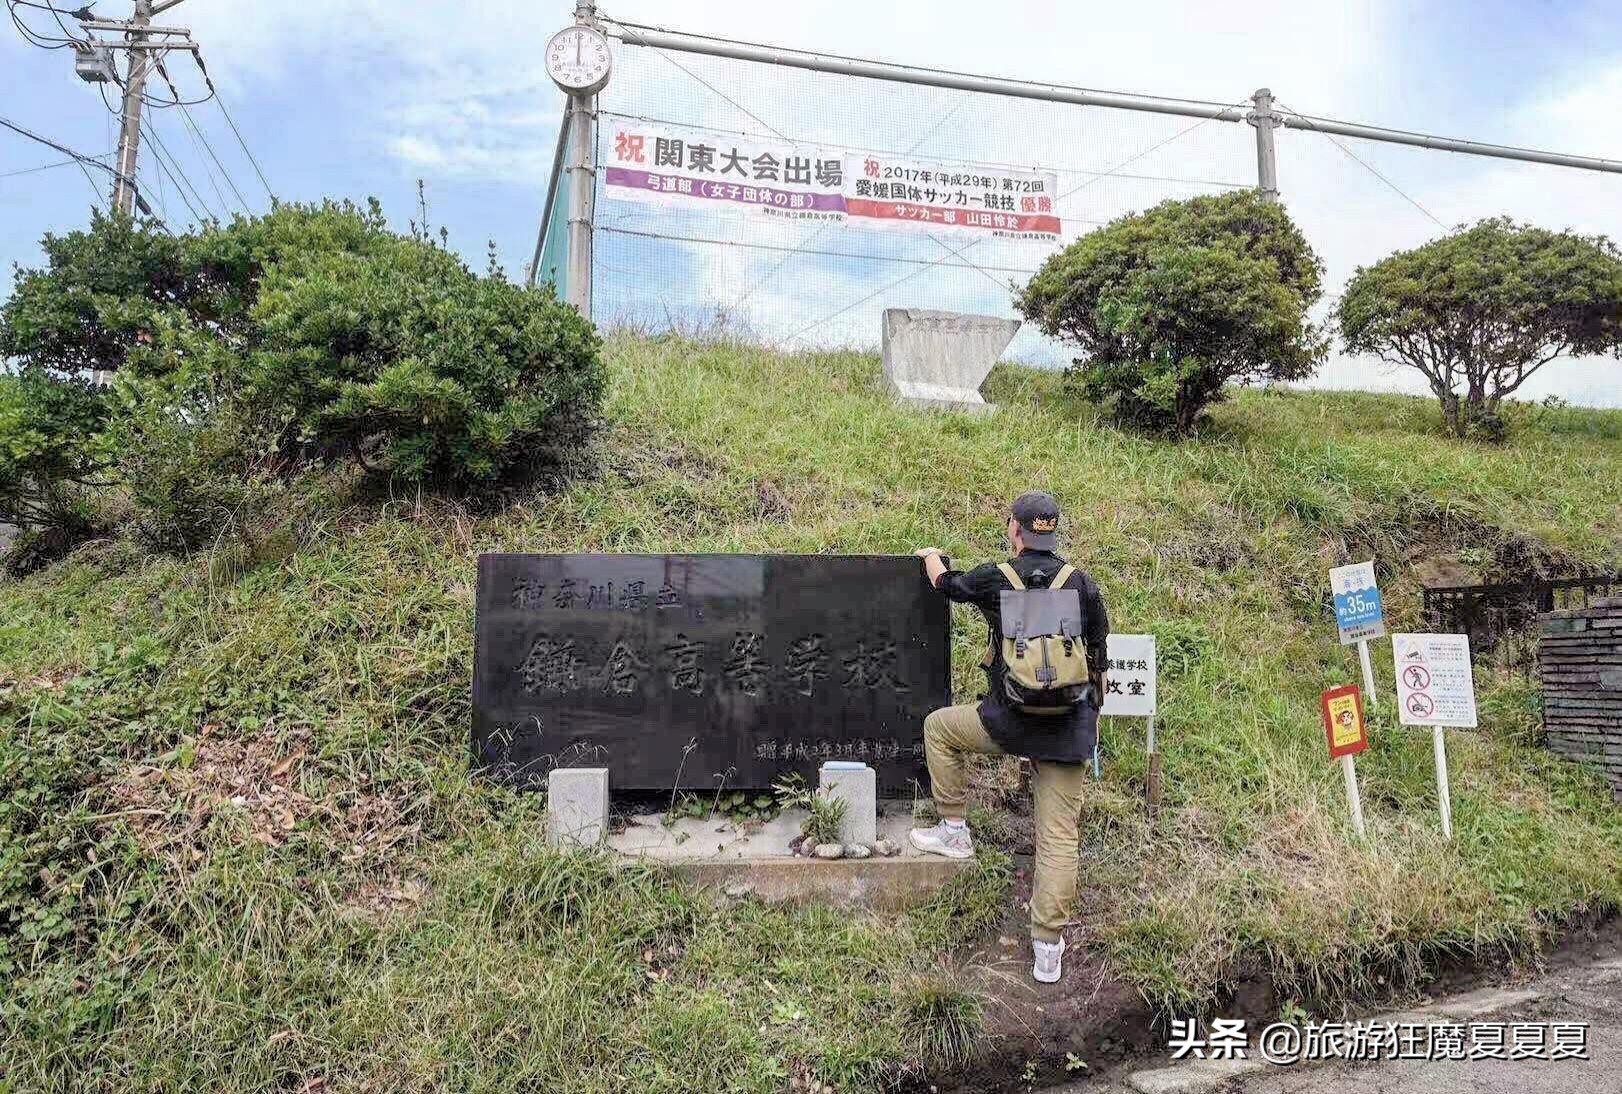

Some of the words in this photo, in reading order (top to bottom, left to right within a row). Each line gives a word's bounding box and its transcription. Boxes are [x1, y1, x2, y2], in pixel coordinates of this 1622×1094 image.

[615, 131, 645, 164] 祝
[655, 136, 844, 188] 関東大会出場
[864, 158, 880, 179] 祝
[856, 179, 1015, 211] 愛媛国体サッカー競技
[1020, 195, 1052, 213] 優勝
[896, 204, 956, 223] サッカー部
